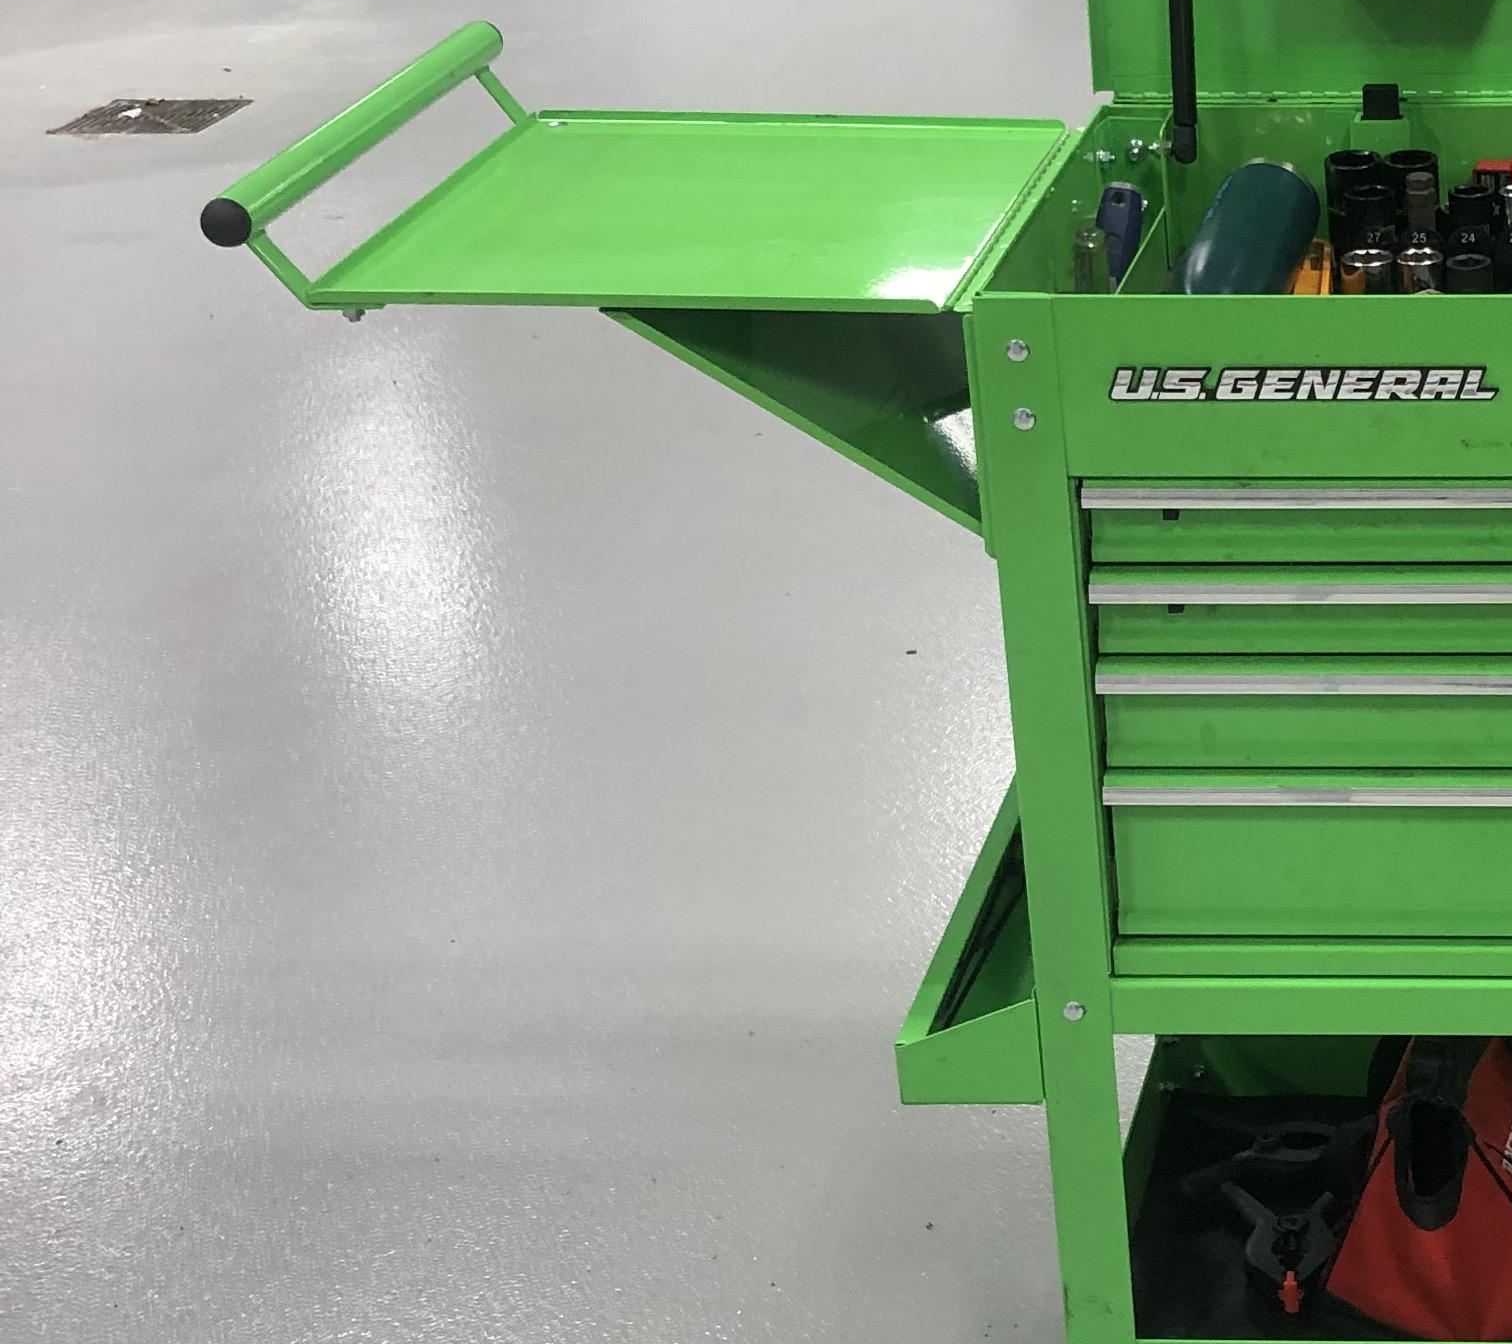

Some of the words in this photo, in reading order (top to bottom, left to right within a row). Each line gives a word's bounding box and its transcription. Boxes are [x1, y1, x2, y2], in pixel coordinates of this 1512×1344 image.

[1367, 232, 1382, 243] 27
[1412, 232, 1427, 244] 25
[1461, 232, 1476, 243] 24
[1111, 368, 1207, 400] U.S.
[1215, 367, 1497, 400] GENERAL
